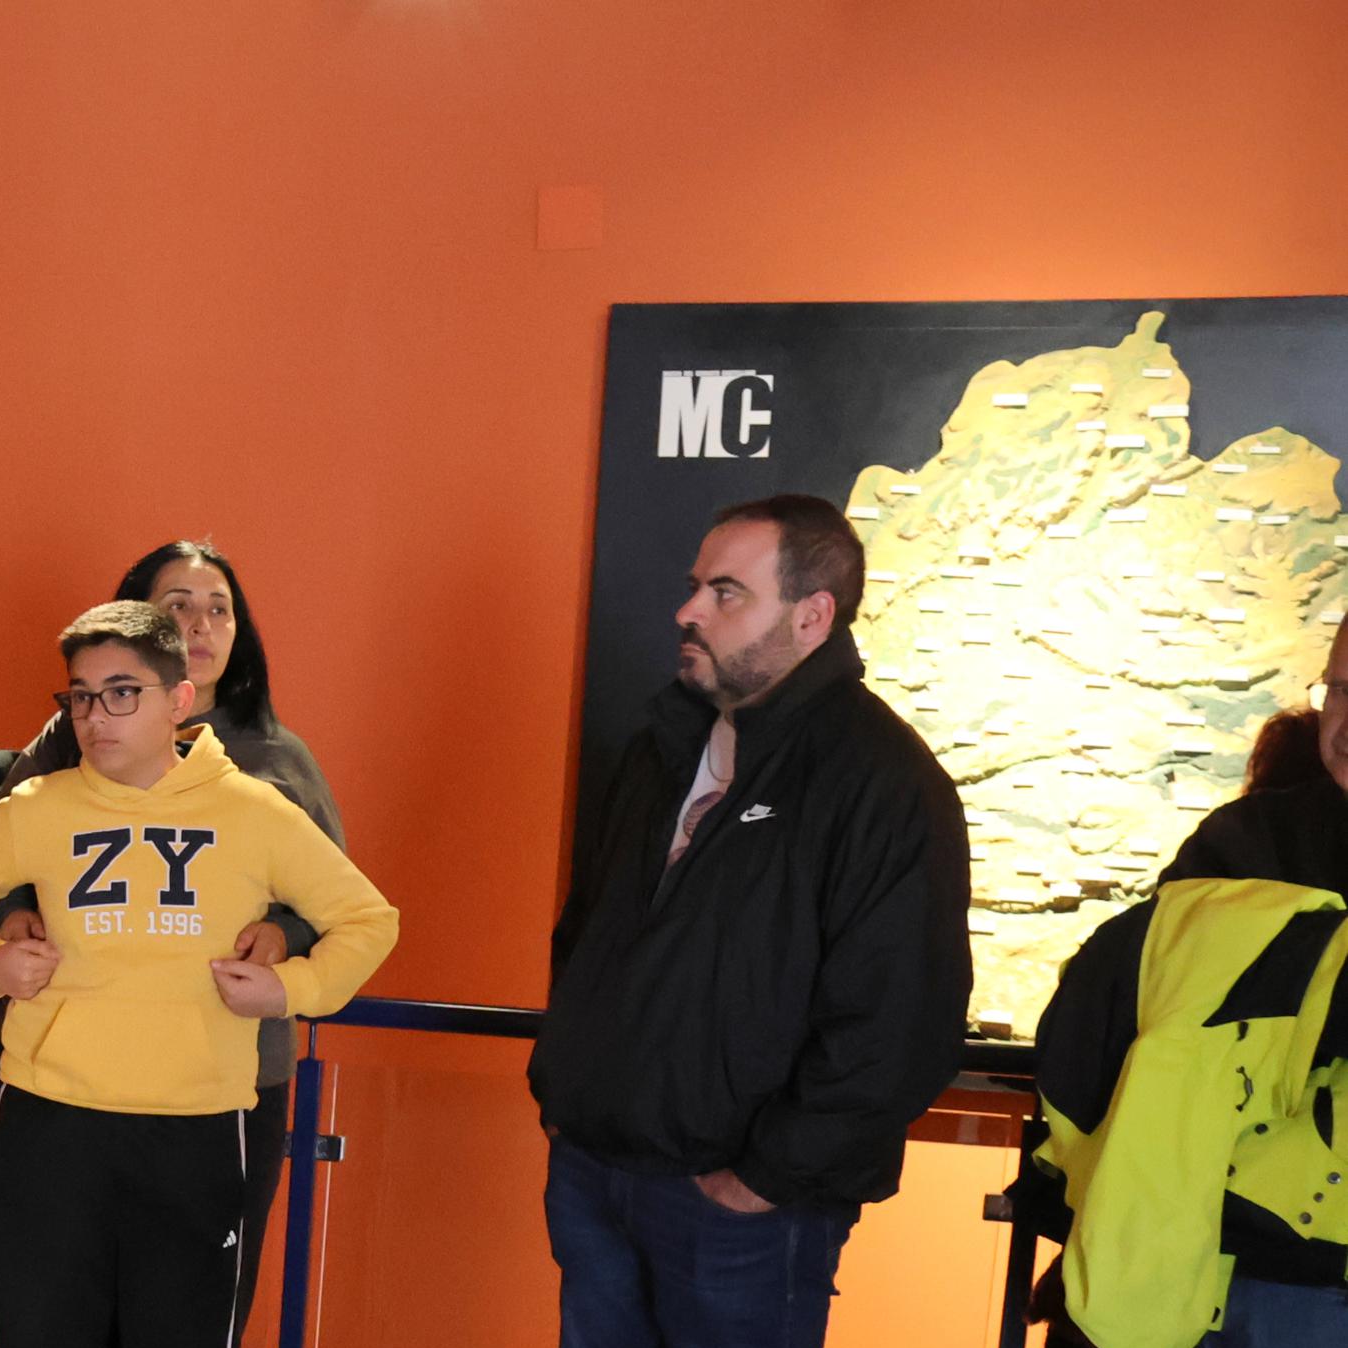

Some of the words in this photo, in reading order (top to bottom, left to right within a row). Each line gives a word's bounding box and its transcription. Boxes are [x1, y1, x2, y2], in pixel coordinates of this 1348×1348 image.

[68, 825, 217, 911] ZY
[85, 911, 133, 935] EST.
[146, 911, 203, 935] 1996
